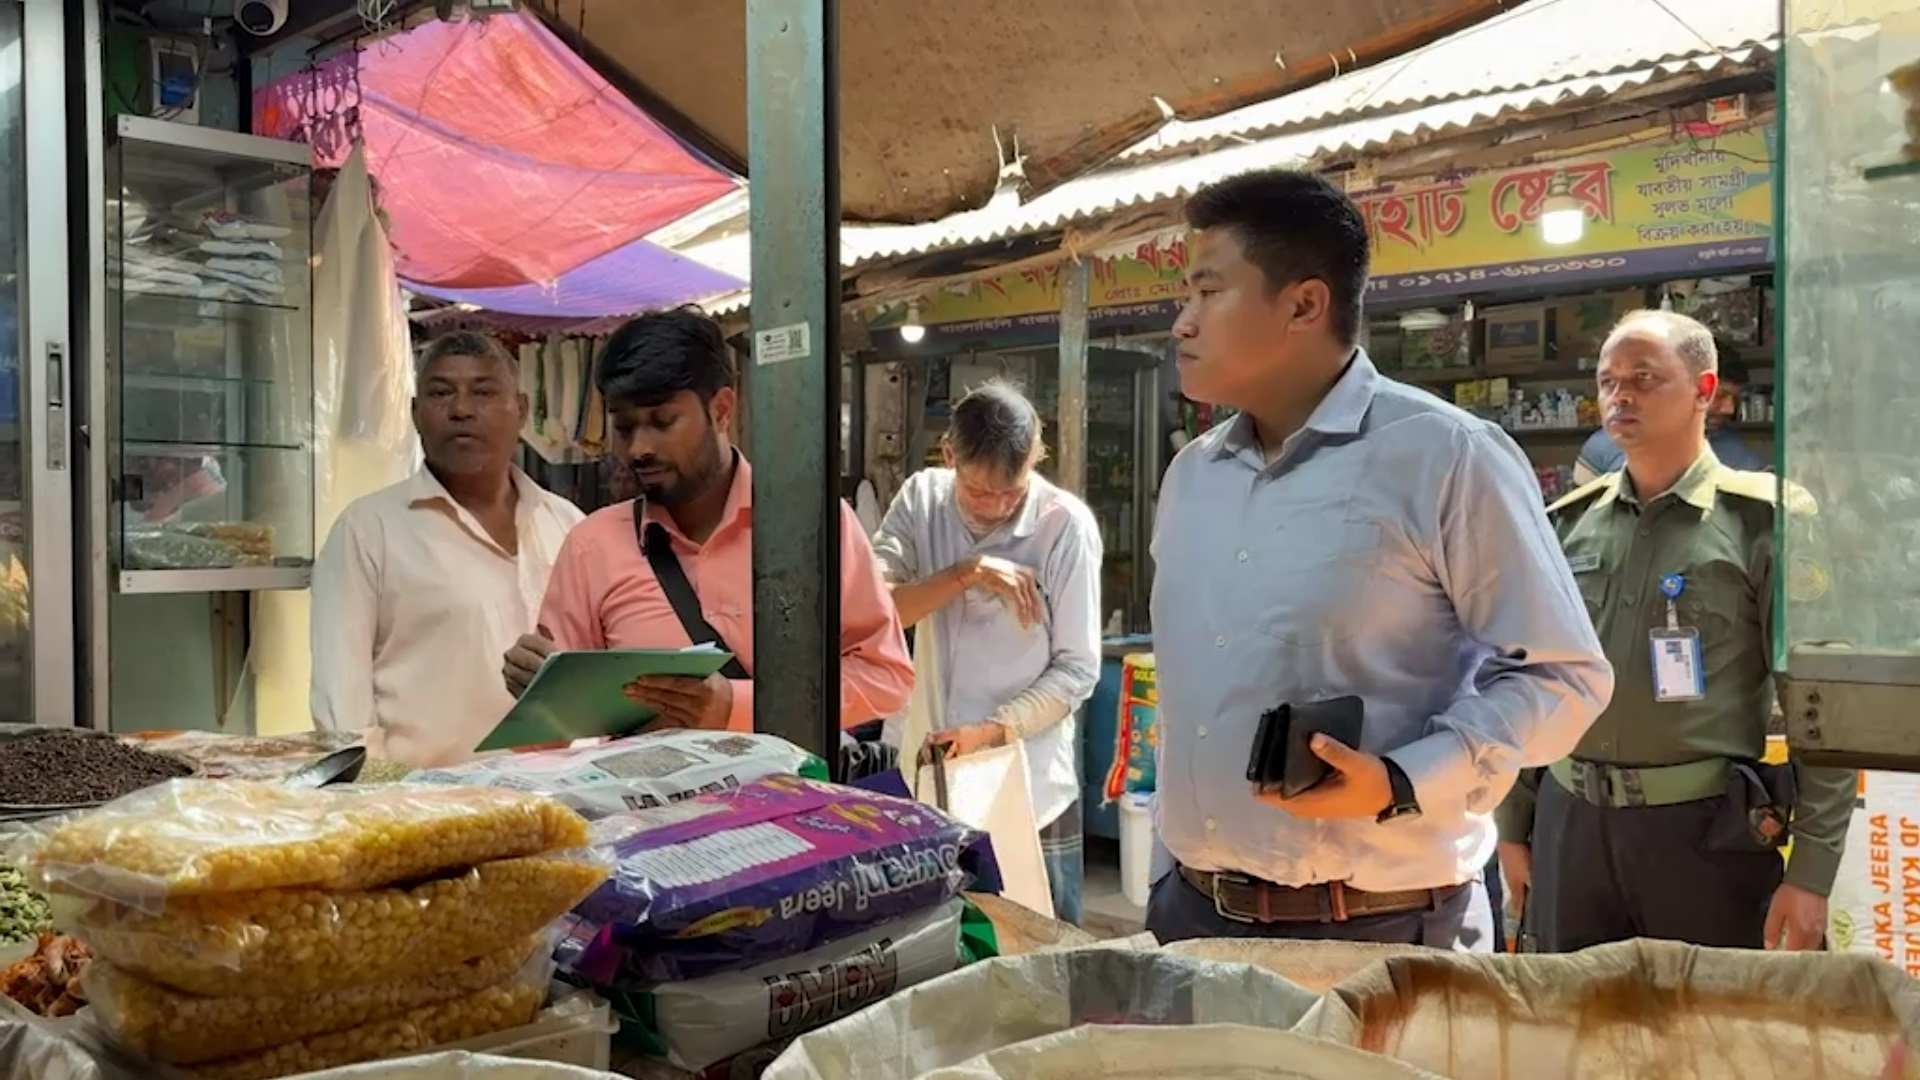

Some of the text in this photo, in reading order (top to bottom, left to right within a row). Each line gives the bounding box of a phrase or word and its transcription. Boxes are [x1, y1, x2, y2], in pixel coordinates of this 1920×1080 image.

[1869, 813, 1891, 894] JEERA
[779, 881, 850, 920] Jeera
[1904, 933, 1920, 977] JEE
